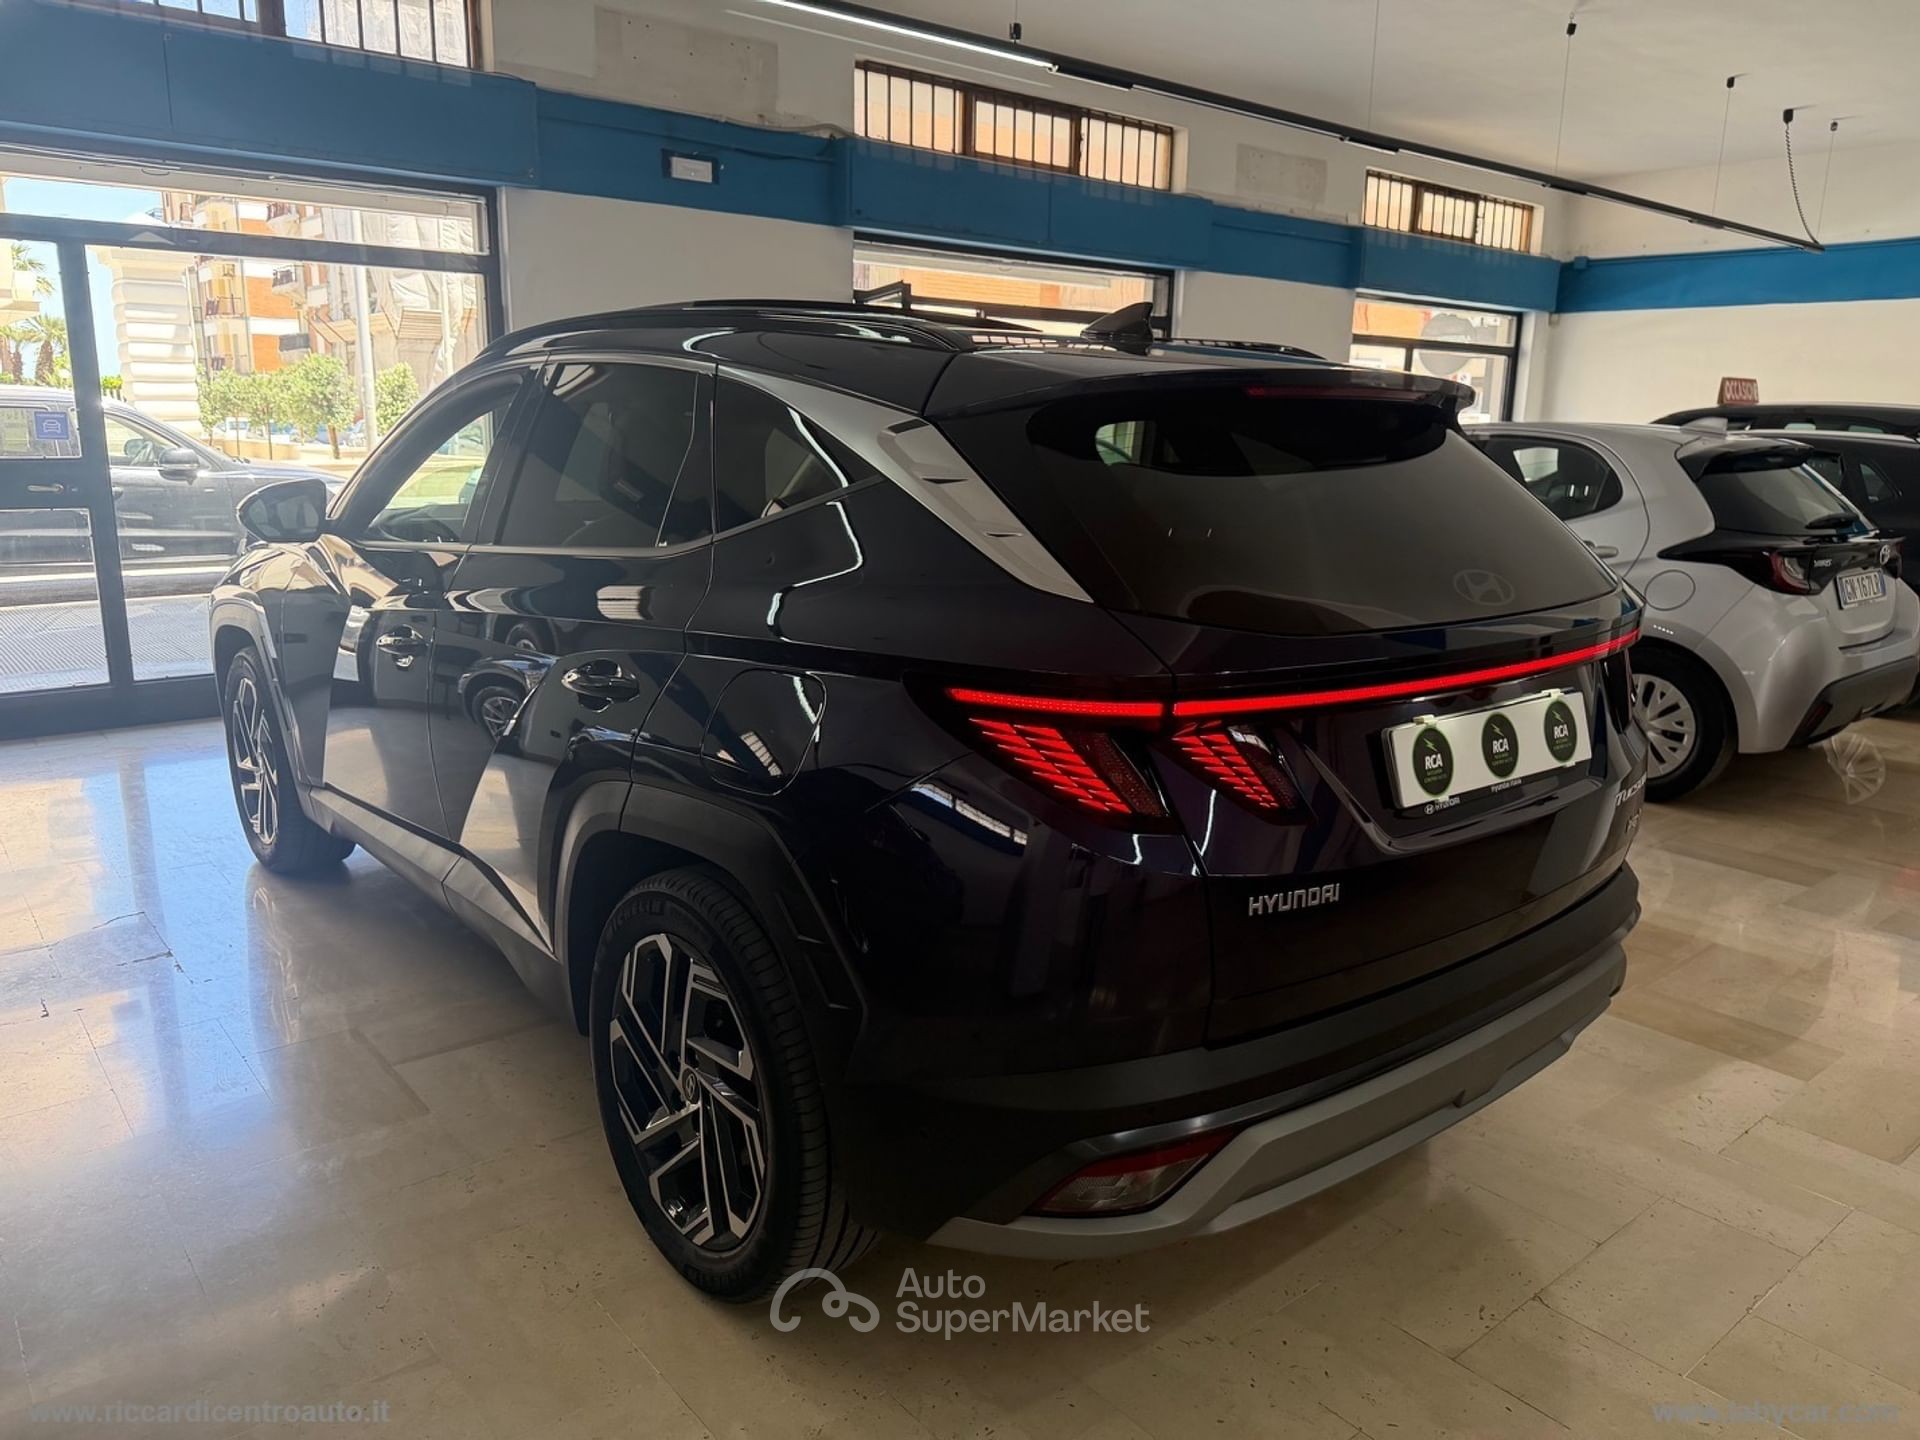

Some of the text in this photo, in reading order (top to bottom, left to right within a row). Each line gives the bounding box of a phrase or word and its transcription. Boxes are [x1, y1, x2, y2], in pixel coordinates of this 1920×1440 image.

[1554, 723, 1569, 740] RCA
[1492, 737, 1510, 754] RCA
[1424, 752, 1444, 771] RCA
[1248, 882, 1341, 917] HYUNDAI
